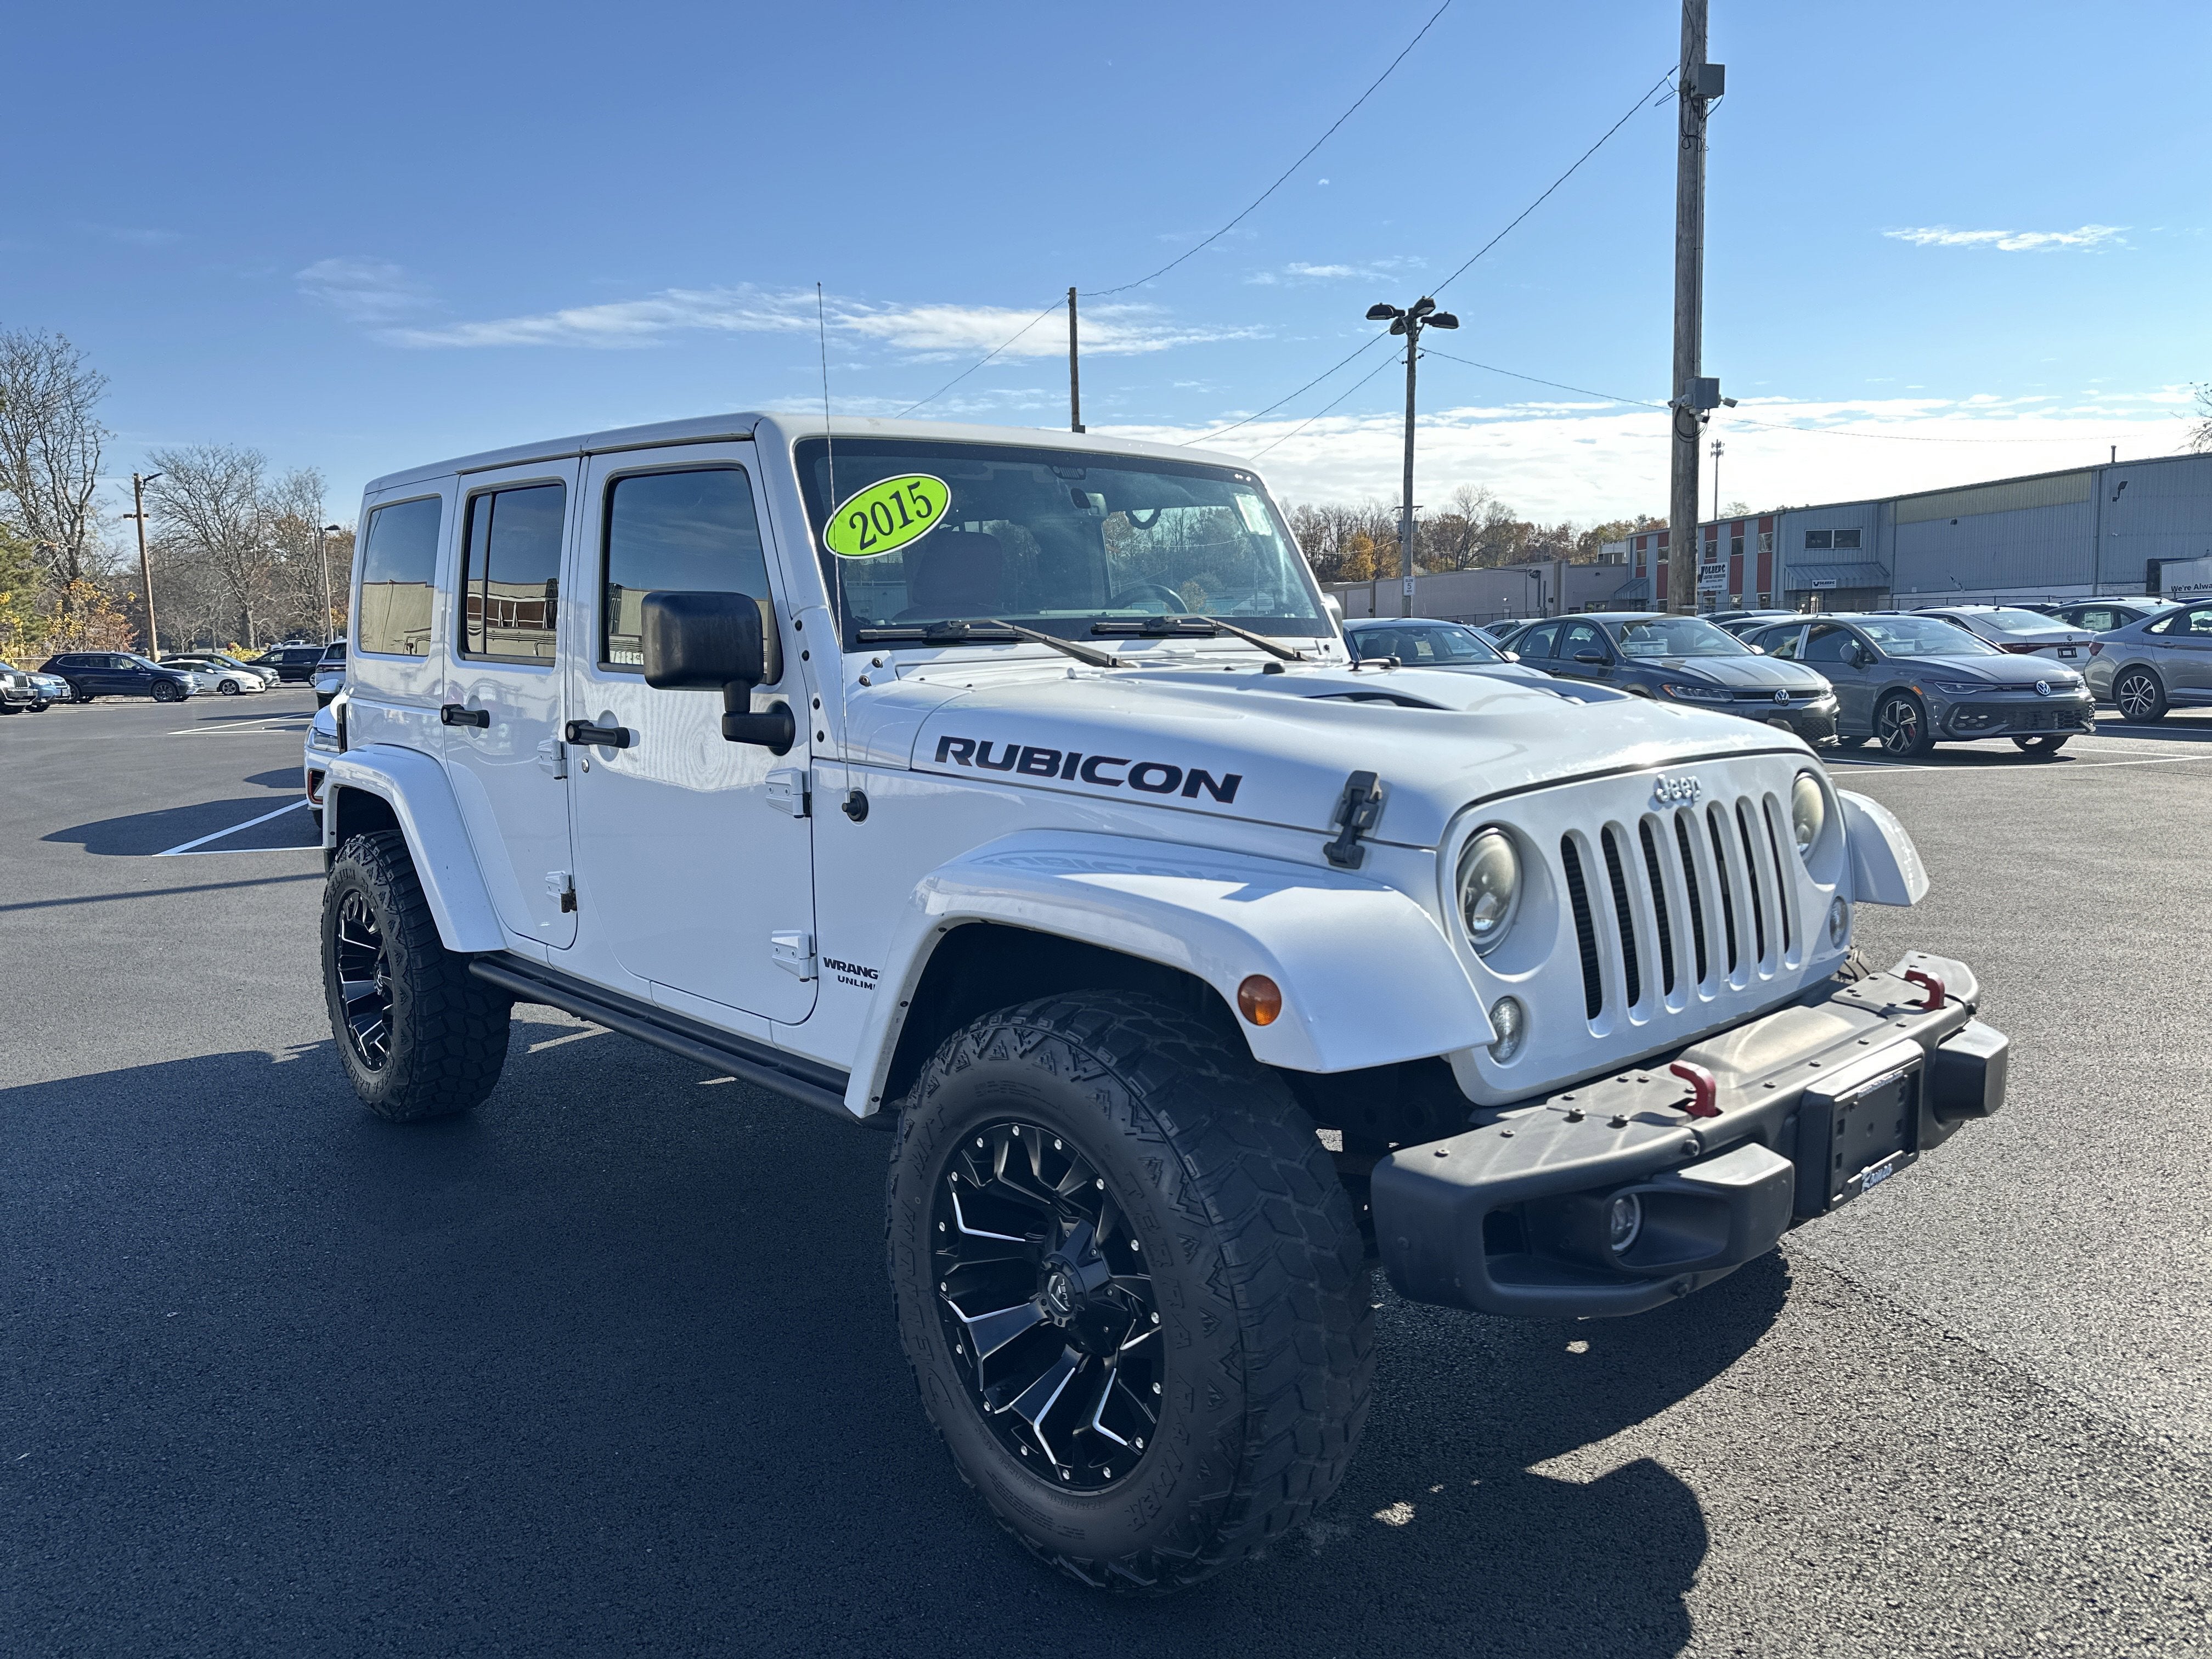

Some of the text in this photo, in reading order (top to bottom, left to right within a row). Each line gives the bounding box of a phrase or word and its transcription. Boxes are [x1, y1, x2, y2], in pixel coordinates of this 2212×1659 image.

[849, 481, 932, 550] 2015
[935, 736, 1243, 804] RUBICON
[1656, 774, 1702, 802] Jeep
[823, 957, 880, 980] WRANG
[1060, 1278, 1071, 1307] FUEL
